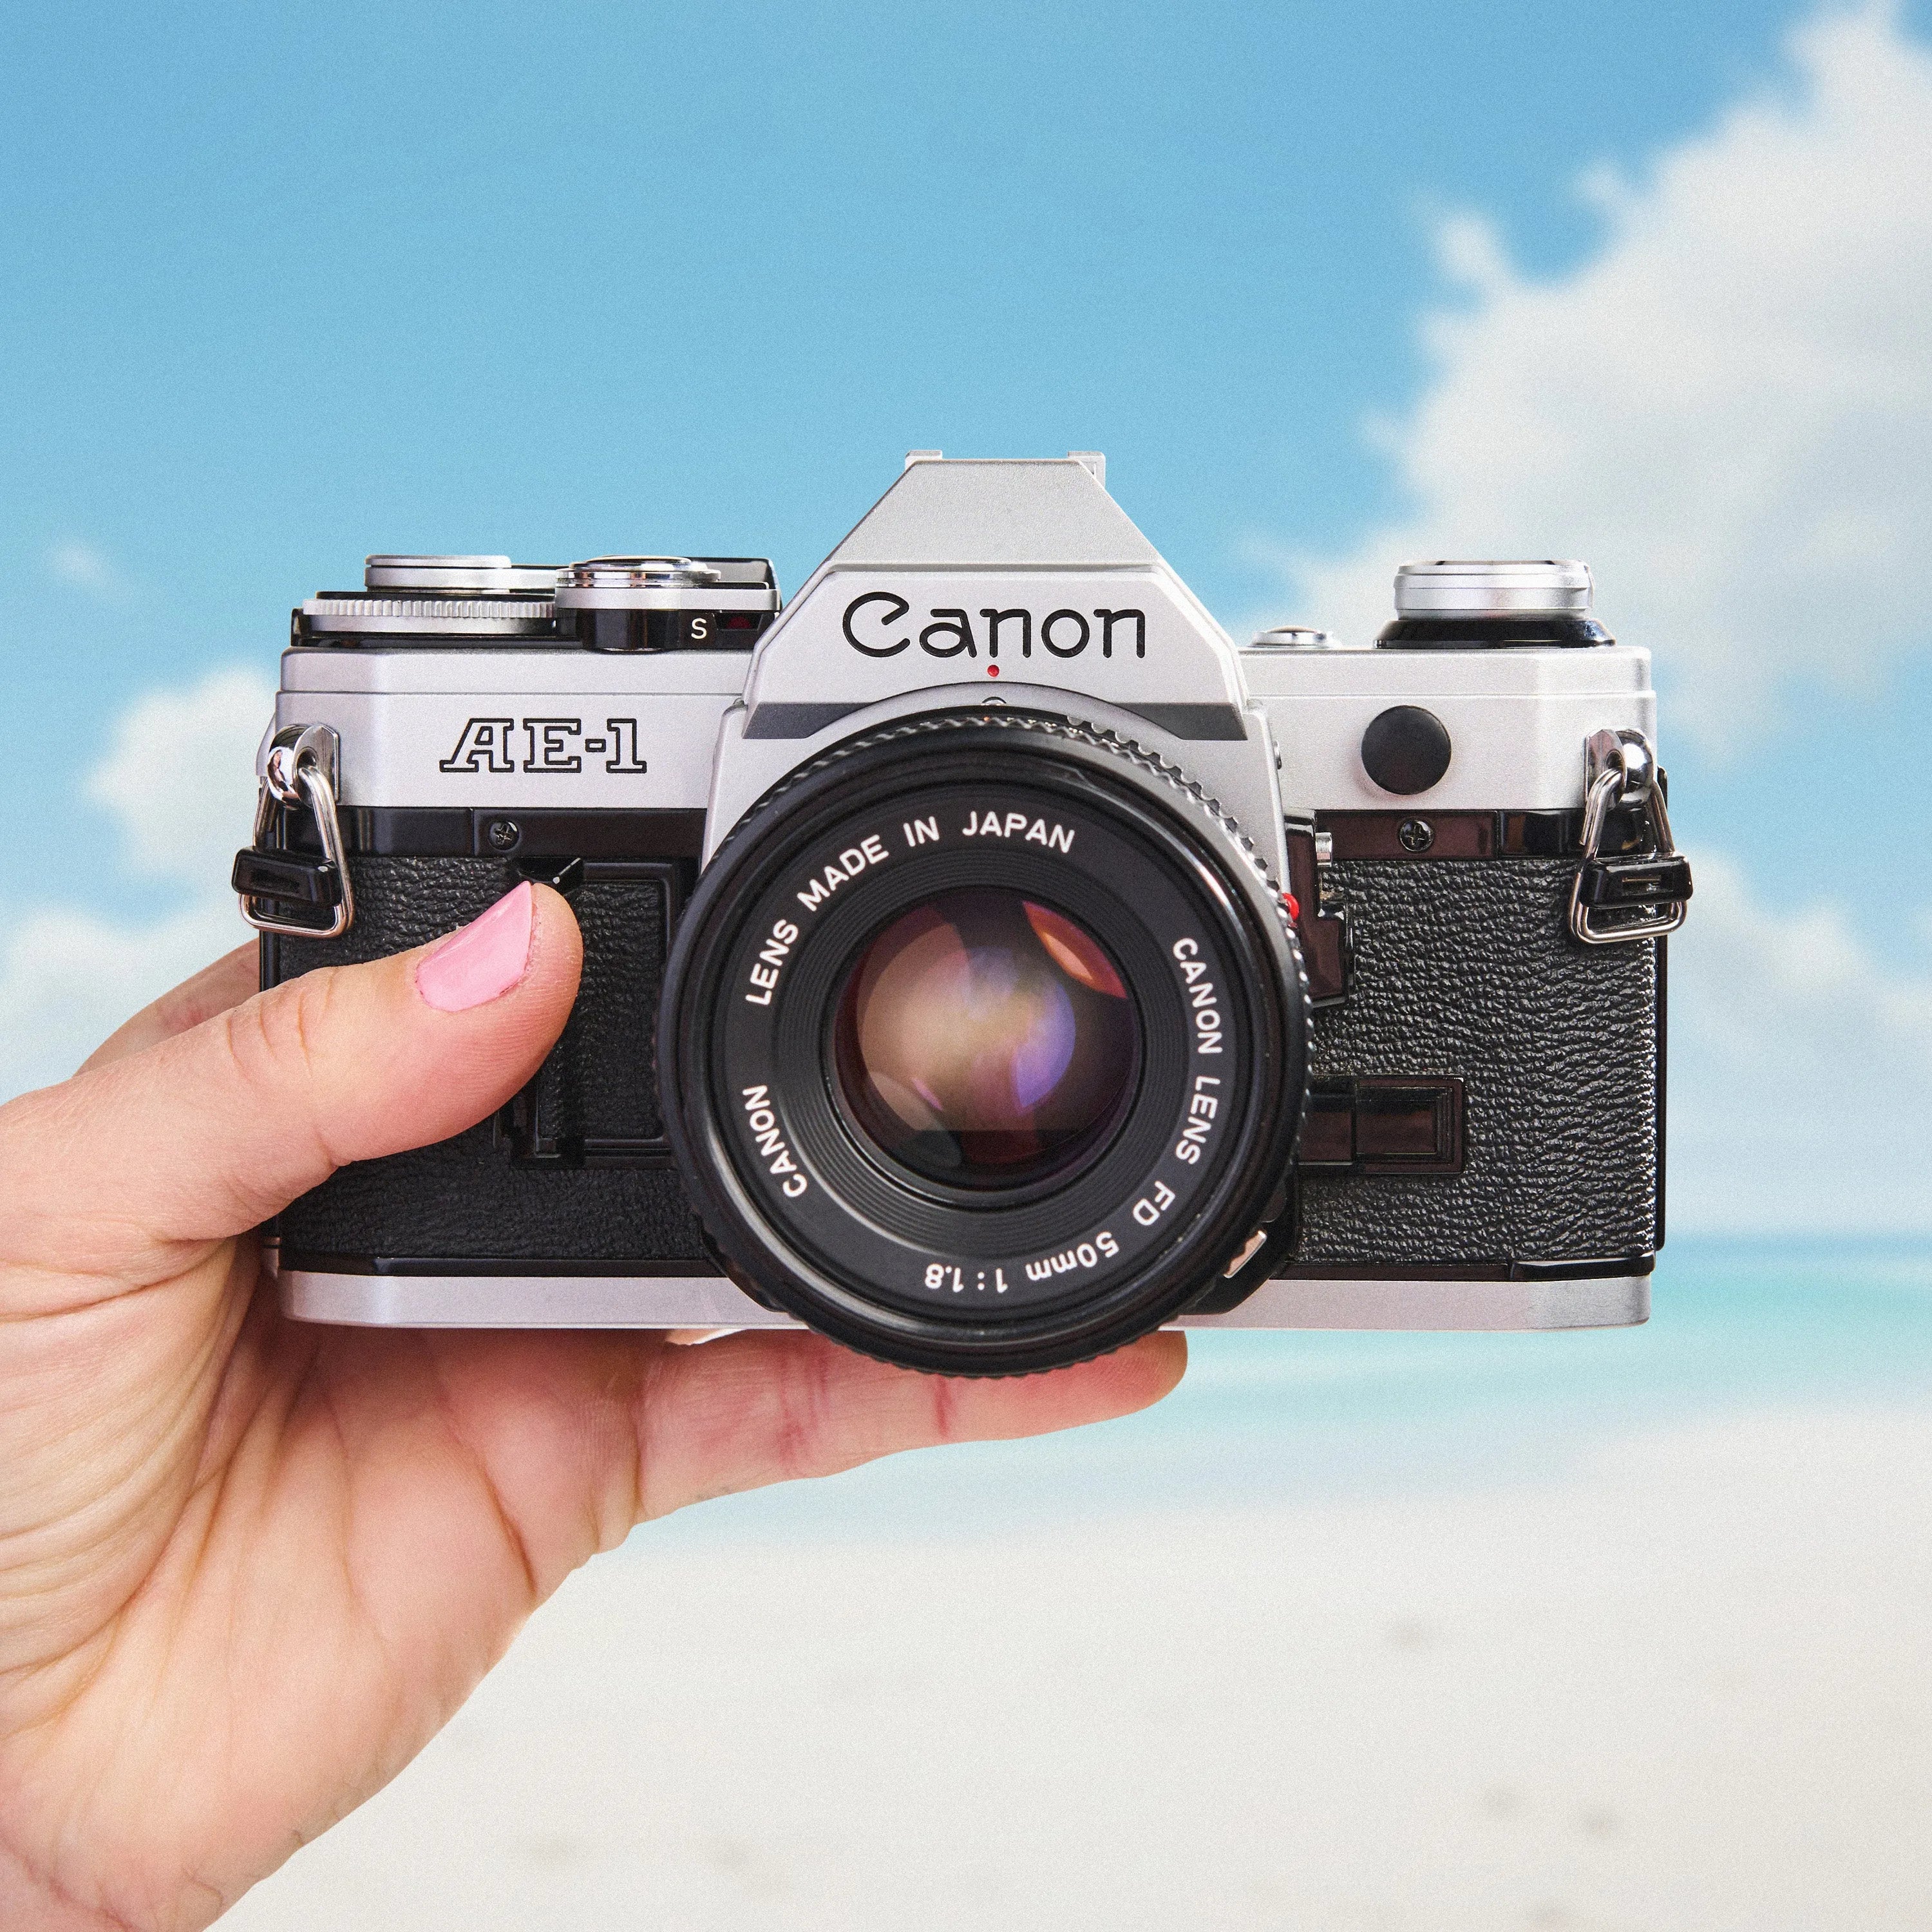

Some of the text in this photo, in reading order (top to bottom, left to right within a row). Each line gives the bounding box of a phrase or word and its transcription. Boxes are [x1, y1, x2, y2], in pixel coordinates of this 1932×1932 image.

[691, 618, 707, 640] S
[842, 591, 1146, 658] Canon
[439, 717, 647, 773] AE-1
[743, 811, 1075, 1198] CANON LENS MADE IN JAPAN
[1173, 938, 1223, 1054] CANON
[1175, 1075, 1220, 1164] LENS
[1132, 1180, 1176, 1226] FD
[1025, 1231, 1120, 1281] 50mm
